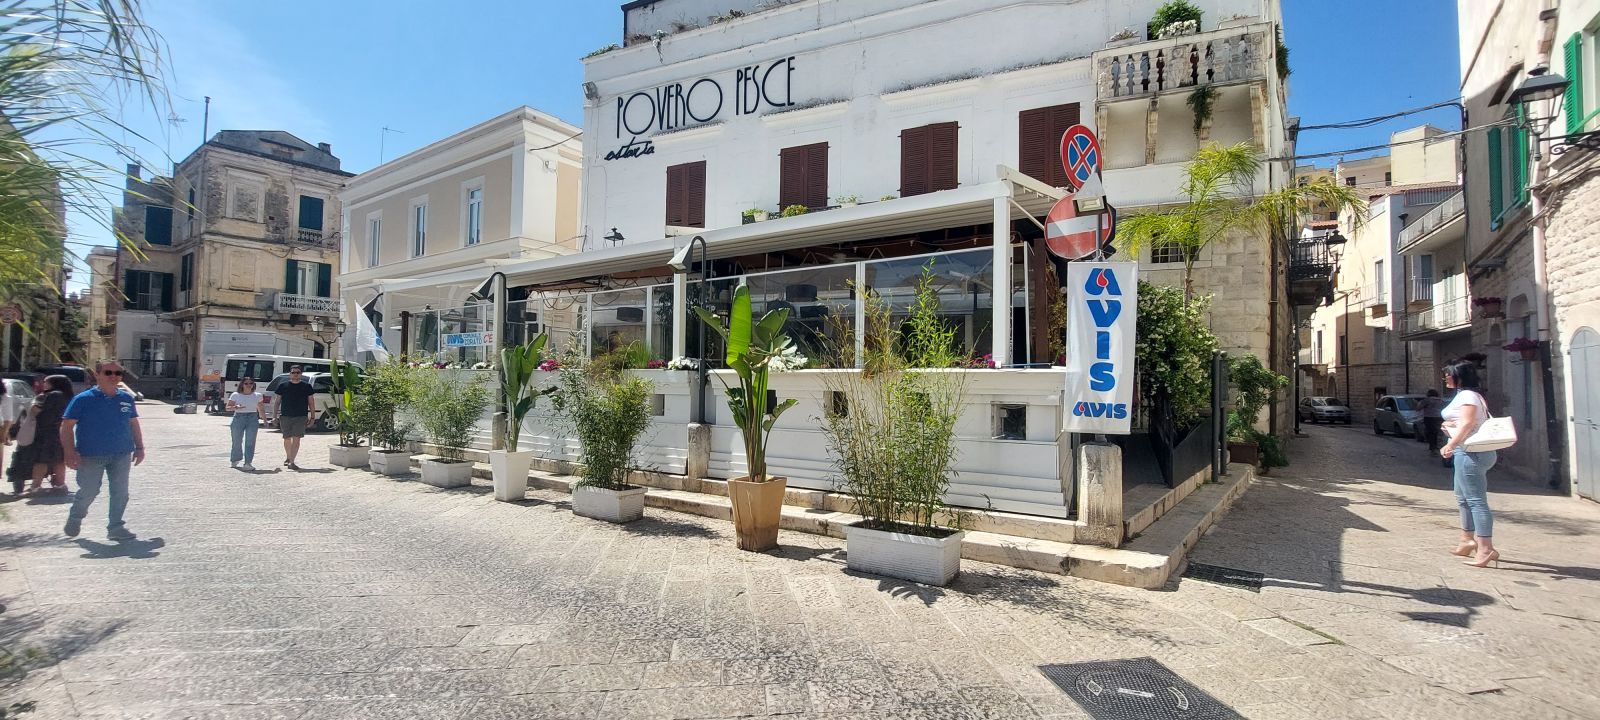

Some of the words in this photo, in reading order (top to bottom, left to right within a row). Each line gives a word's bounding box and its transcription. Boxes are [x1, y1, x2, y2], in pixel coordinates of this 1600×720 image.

[616, 78, 723, 139] POVERO
[735, 56, 796, 116] PESCE
[1084, 267, 1123, 393] AVIS
[1072, 401, 1128, 420] AVIS
